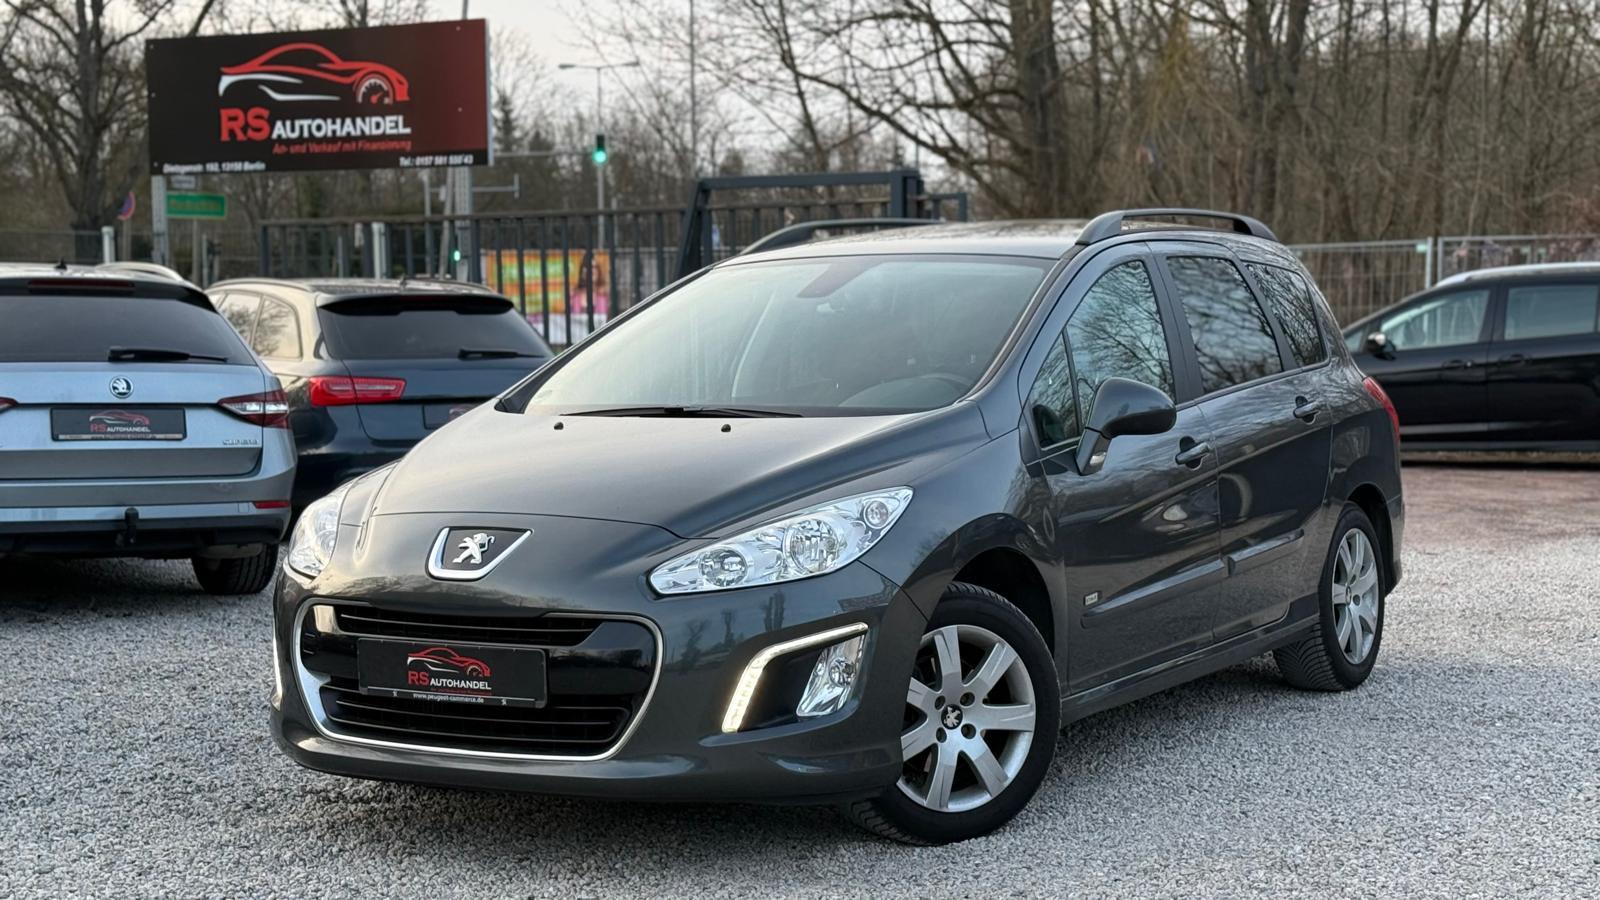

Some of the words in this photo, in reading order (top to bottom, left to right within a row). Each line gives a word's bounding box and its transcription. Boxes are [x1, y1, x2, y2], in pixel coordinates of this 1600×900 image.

[220, 107, 270, 141] RS
[272, 115, 411, 139] AUTOHANDEL
[289, 142, 307, 154] und
[308, 141, 341, 154] Verkauf
[341, 140, 357, 152] mit
[357, 139, 412, 153] Finanzierung
[243, 160, 266, 172] Berlin
[90, 423, 106, 433] RS
[408, 671, 429, 685] RS
[430, 678, 491, 690] AUTOHANDEL
